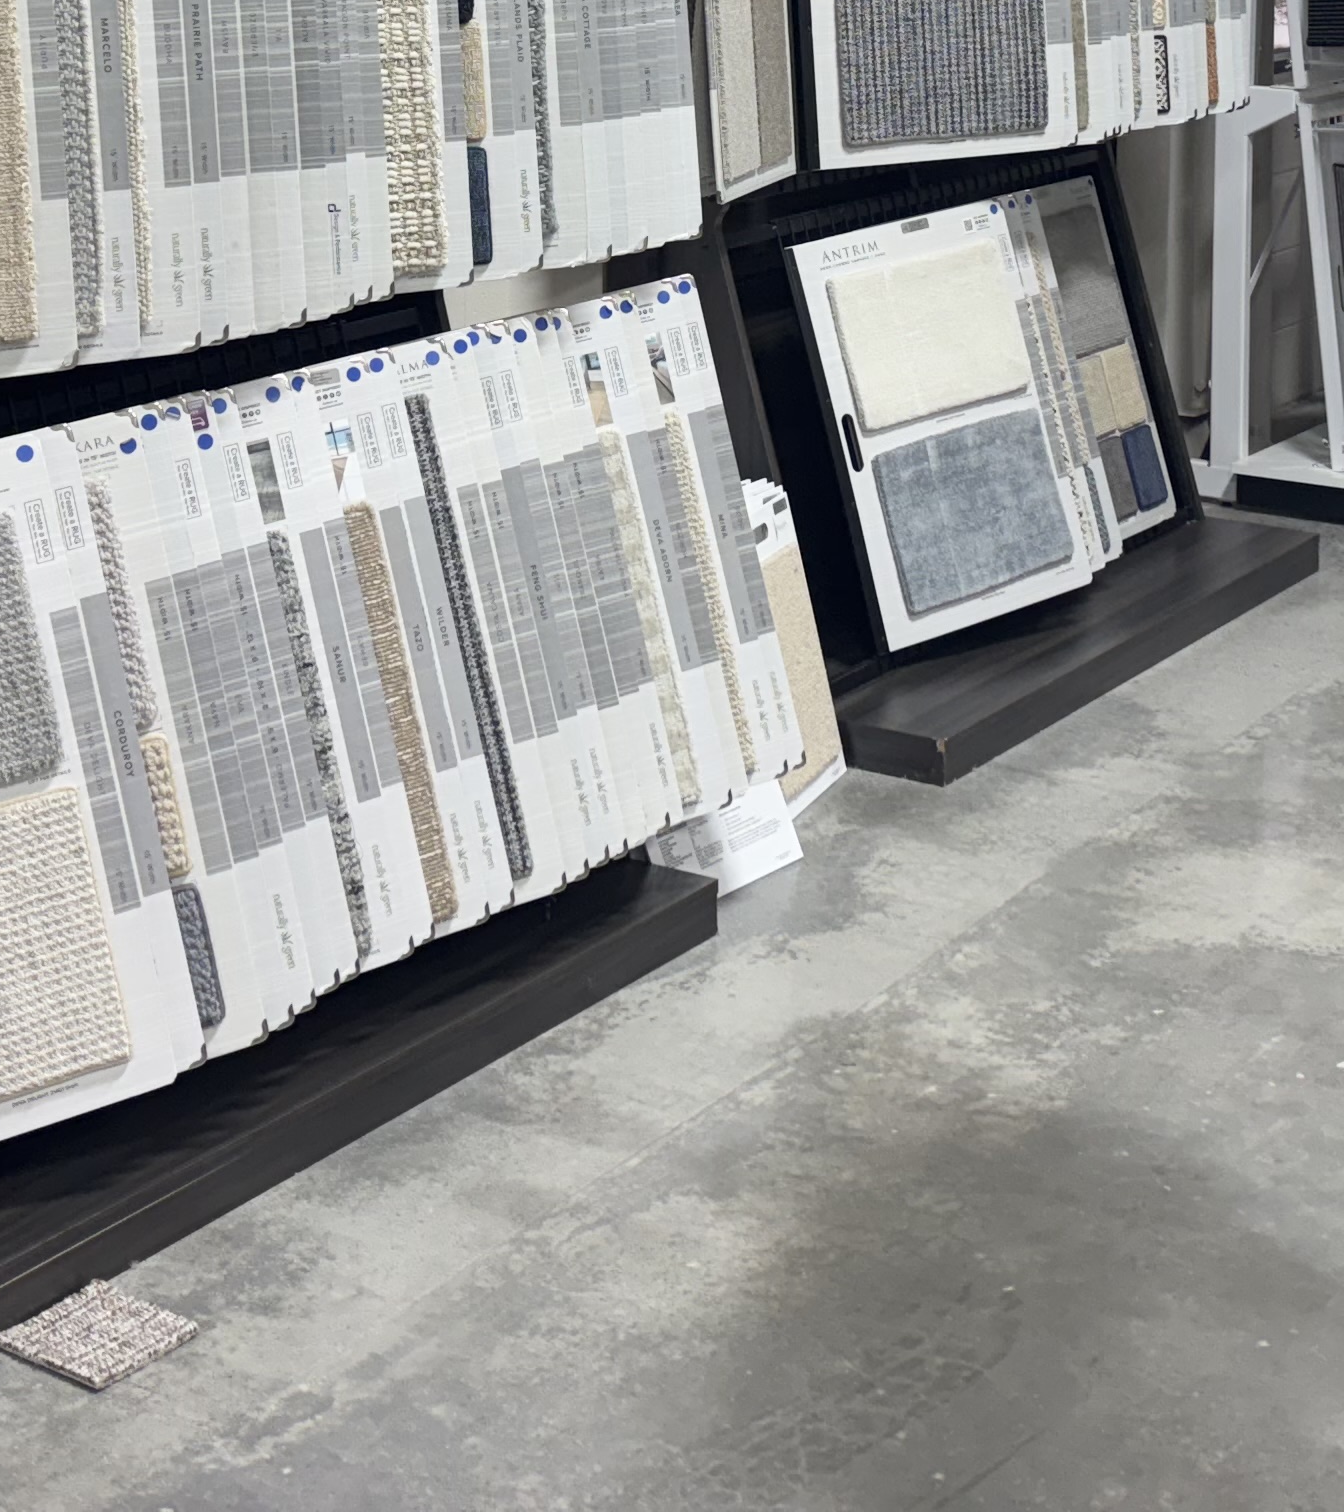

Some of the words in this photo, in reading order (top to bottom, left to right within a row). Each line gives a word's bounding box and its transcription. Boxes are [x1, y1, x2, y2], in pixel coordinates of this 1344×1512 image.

[191, 4, 202, 47] PRAIRIE
[581, 6, 592, 49] COTTAGE
[100, 18, 112, 73] MARCELO
[516, 33, 524, 63] PLAID
[195, 53, 204, 81] PATH
[823, 241, 879, 263] ANTRIM
[529, 564, 542, 592] FENG
[435, 606, 450, 648] WILDER
[332, 646, 346, 683] SANUR
[114, 710, 135, 777] CORDUROY
